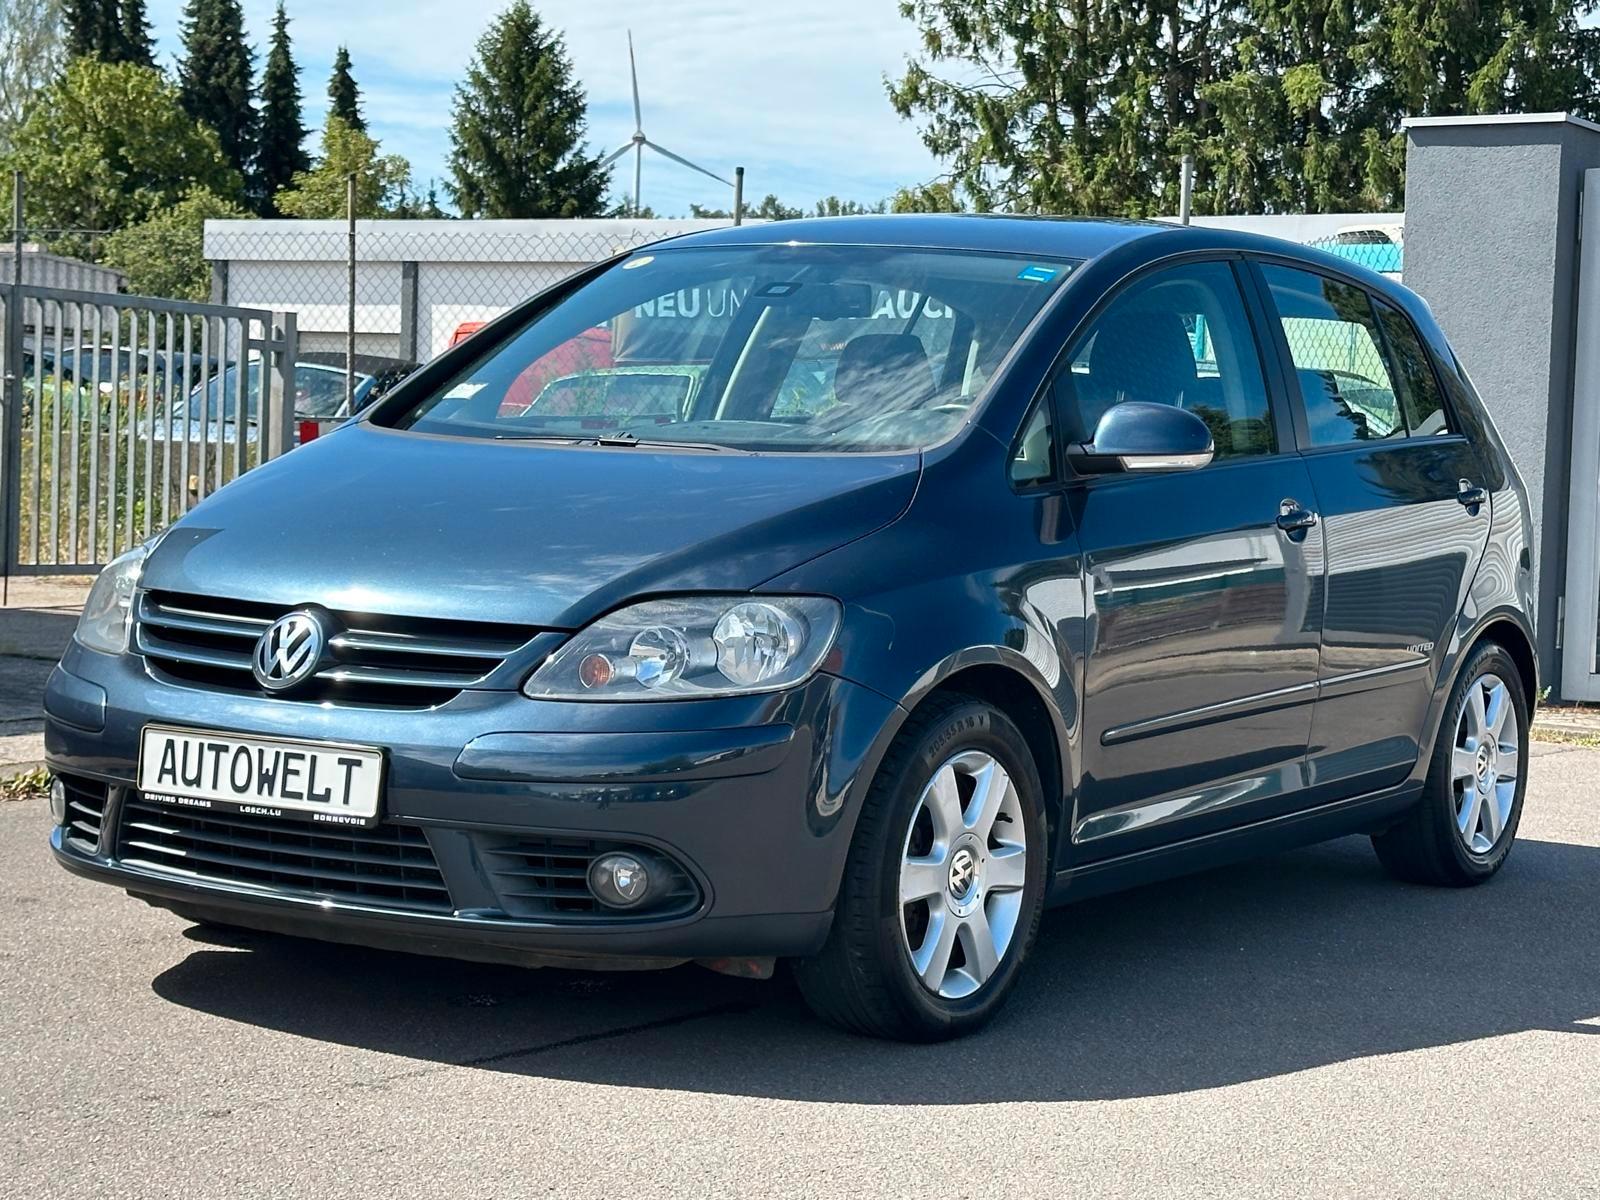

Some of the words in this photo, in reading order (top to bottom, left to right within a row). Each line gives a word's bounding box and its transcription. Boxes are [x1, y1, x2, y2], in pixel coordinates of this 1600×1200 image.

[635, 288, 700, 318] NEU
[1406, 642, 1434, 653] UNITED
[157, 739, 362, 805] AUTOWELT
[178, 797, 211, 808] DREAMS
